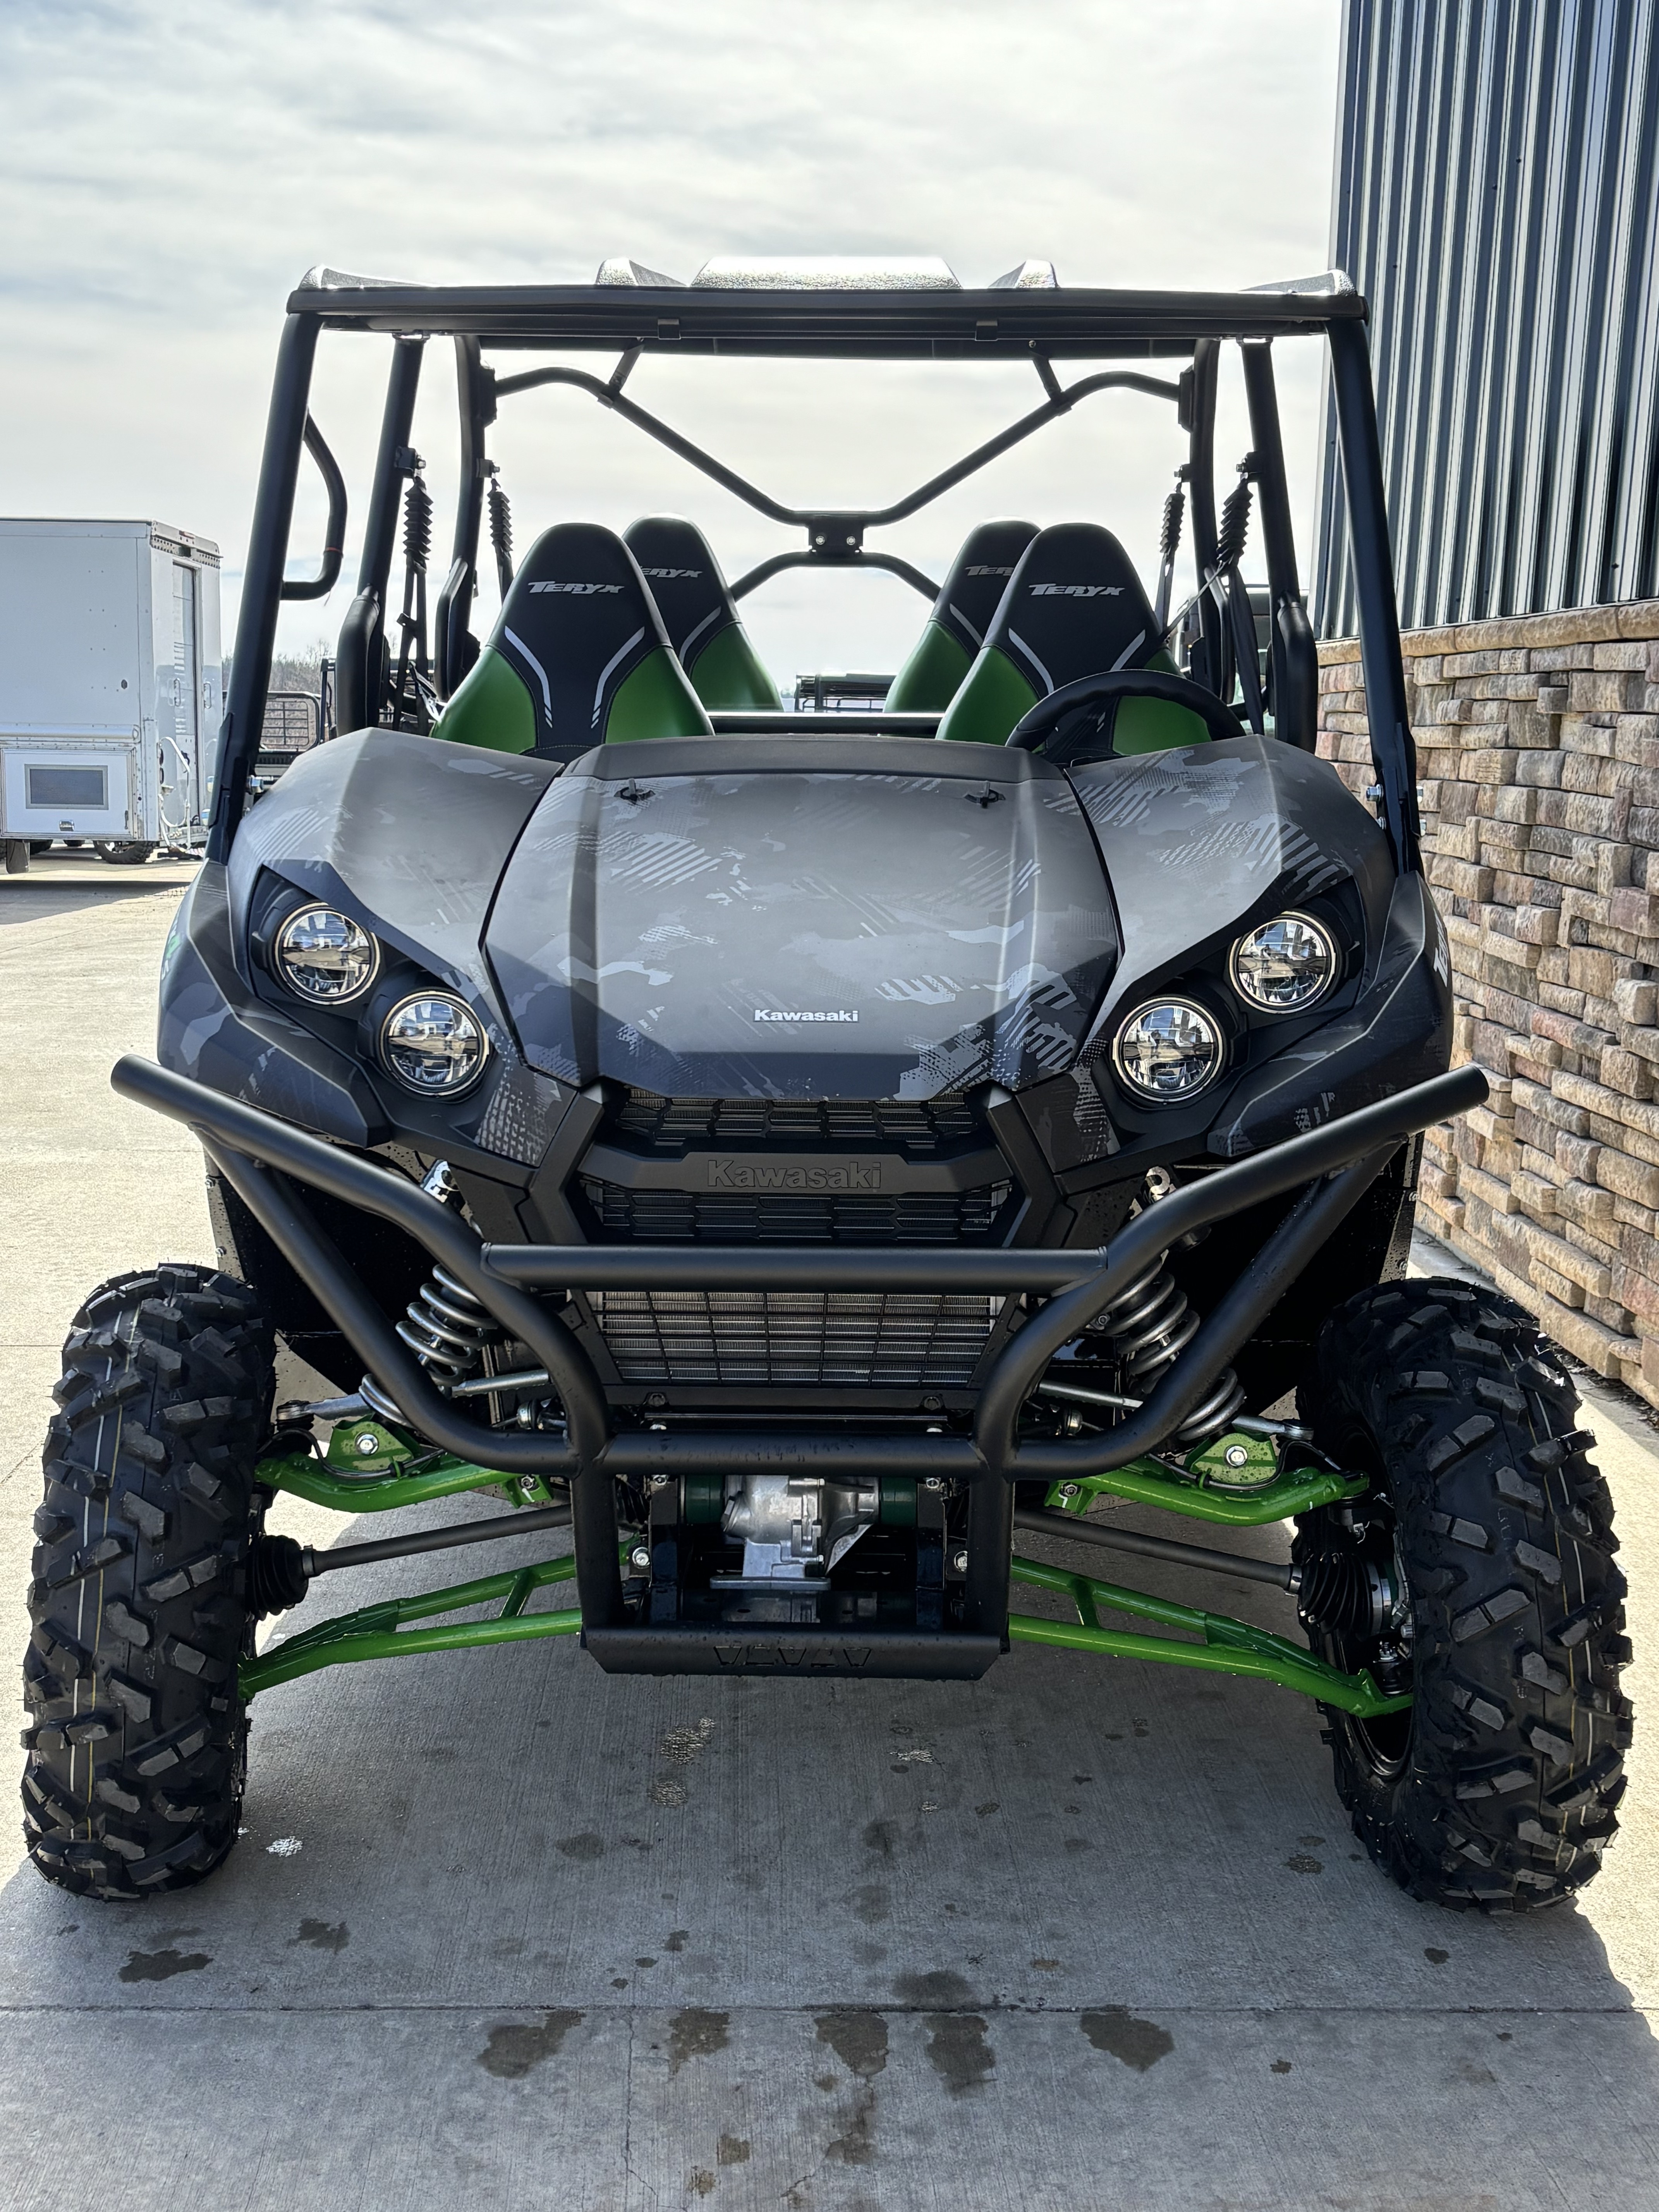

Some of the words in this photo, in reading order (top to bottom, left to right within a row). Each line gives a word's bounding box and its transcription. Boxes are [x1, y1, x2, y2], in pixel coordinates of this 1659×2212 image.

[640, 566, 703, 578] ERYX
[965, 565, 1014, 576] TER
[528, 581, 625, 594] TERYX
[1029, 583, 1125, 596] TERYX
[755, 1009, 858, 1022] Kawasaki
[708, 1160, 881, 1188] Kawasaki
